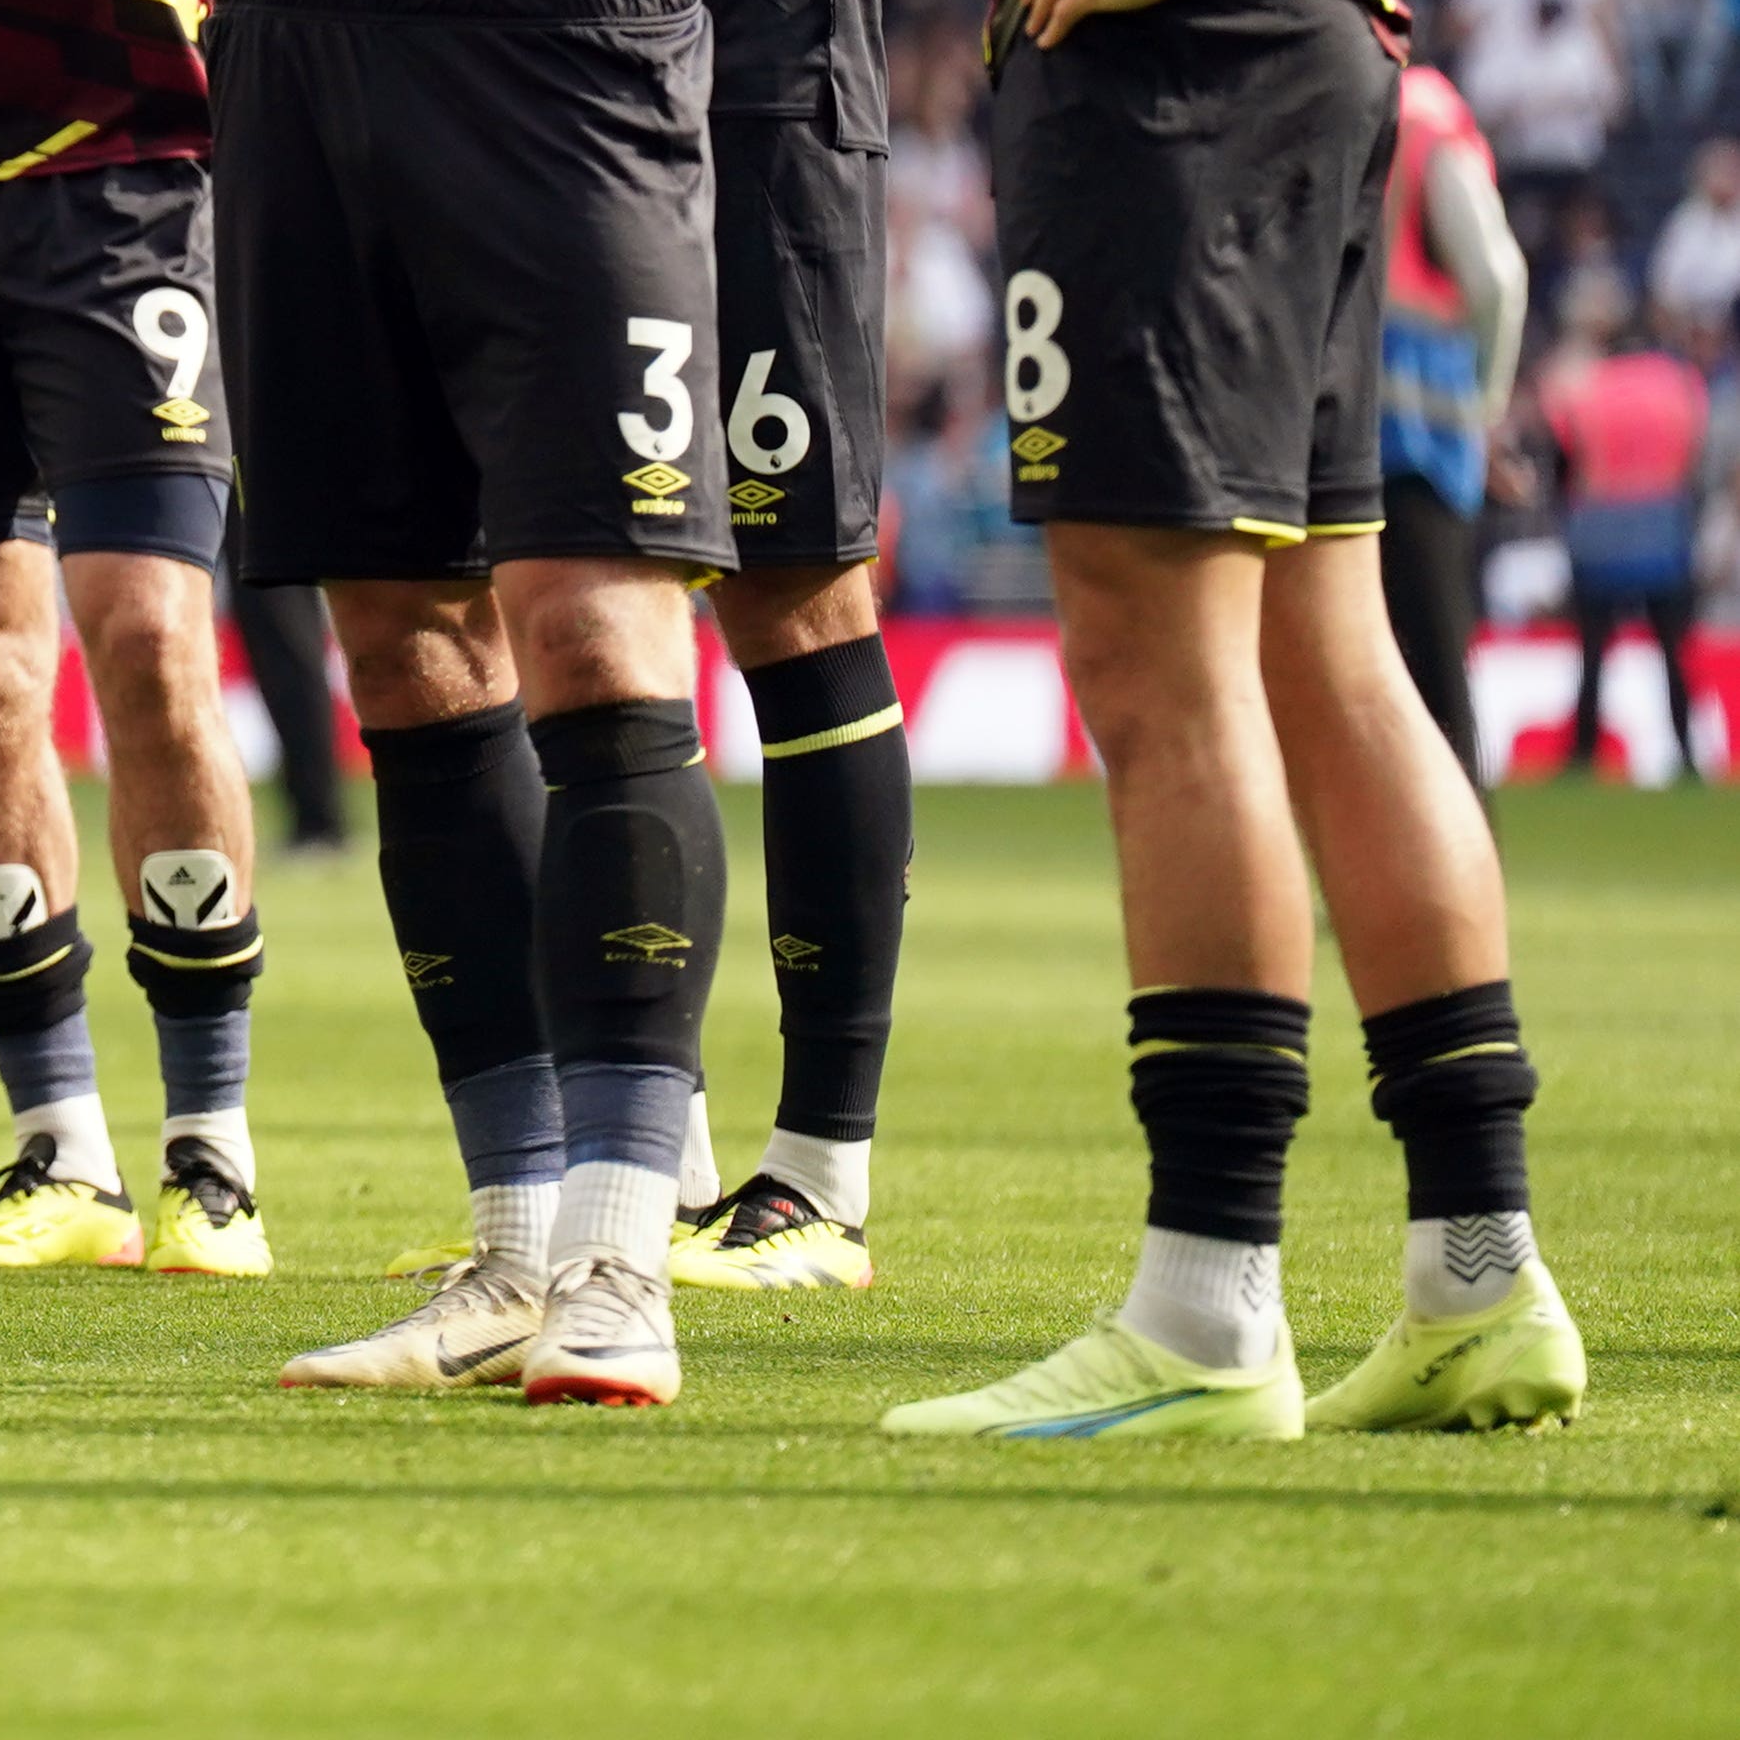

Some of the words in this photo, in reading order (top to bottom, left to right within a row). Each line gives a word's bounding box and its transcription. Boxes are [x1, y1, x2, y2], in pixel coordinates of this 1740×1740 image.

[133, 286, 208, 398] 9
[617, 317, 693, 461] 3
[1004, 269, 1071, 423] 8
[728, 349, 810, 475] 6
[729, 511, 777, 525] umbro
